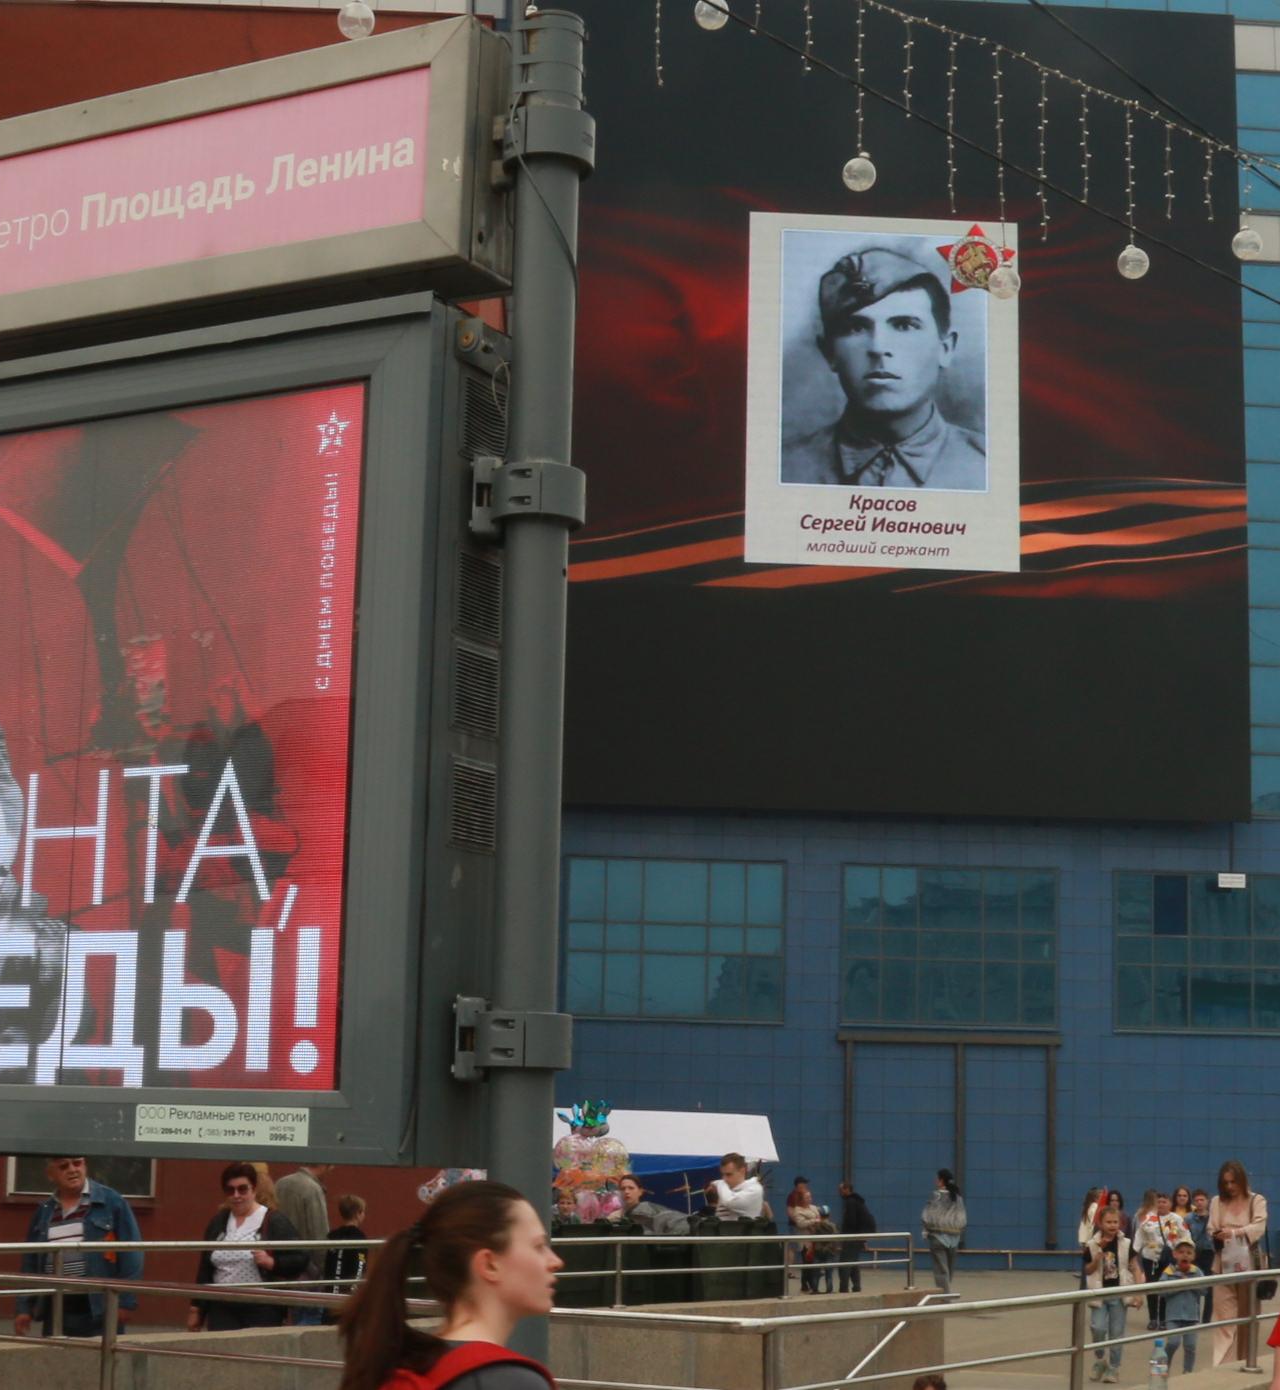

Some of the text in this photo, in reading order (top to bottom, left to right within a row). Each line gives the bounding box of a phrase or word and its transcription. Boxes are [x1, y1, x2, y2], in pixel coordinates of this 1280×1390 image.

[80, 176, 255, 232] Площадь
[265, 136, 415, 195] Ленина
[849, 494, 917, 513] Красов
[800, 514, 967, 535] Сергей Иванович
[806, 541, 950, 558] младший сержант
[138, 1106, 307, 1123] ООО Рекламные технологии
